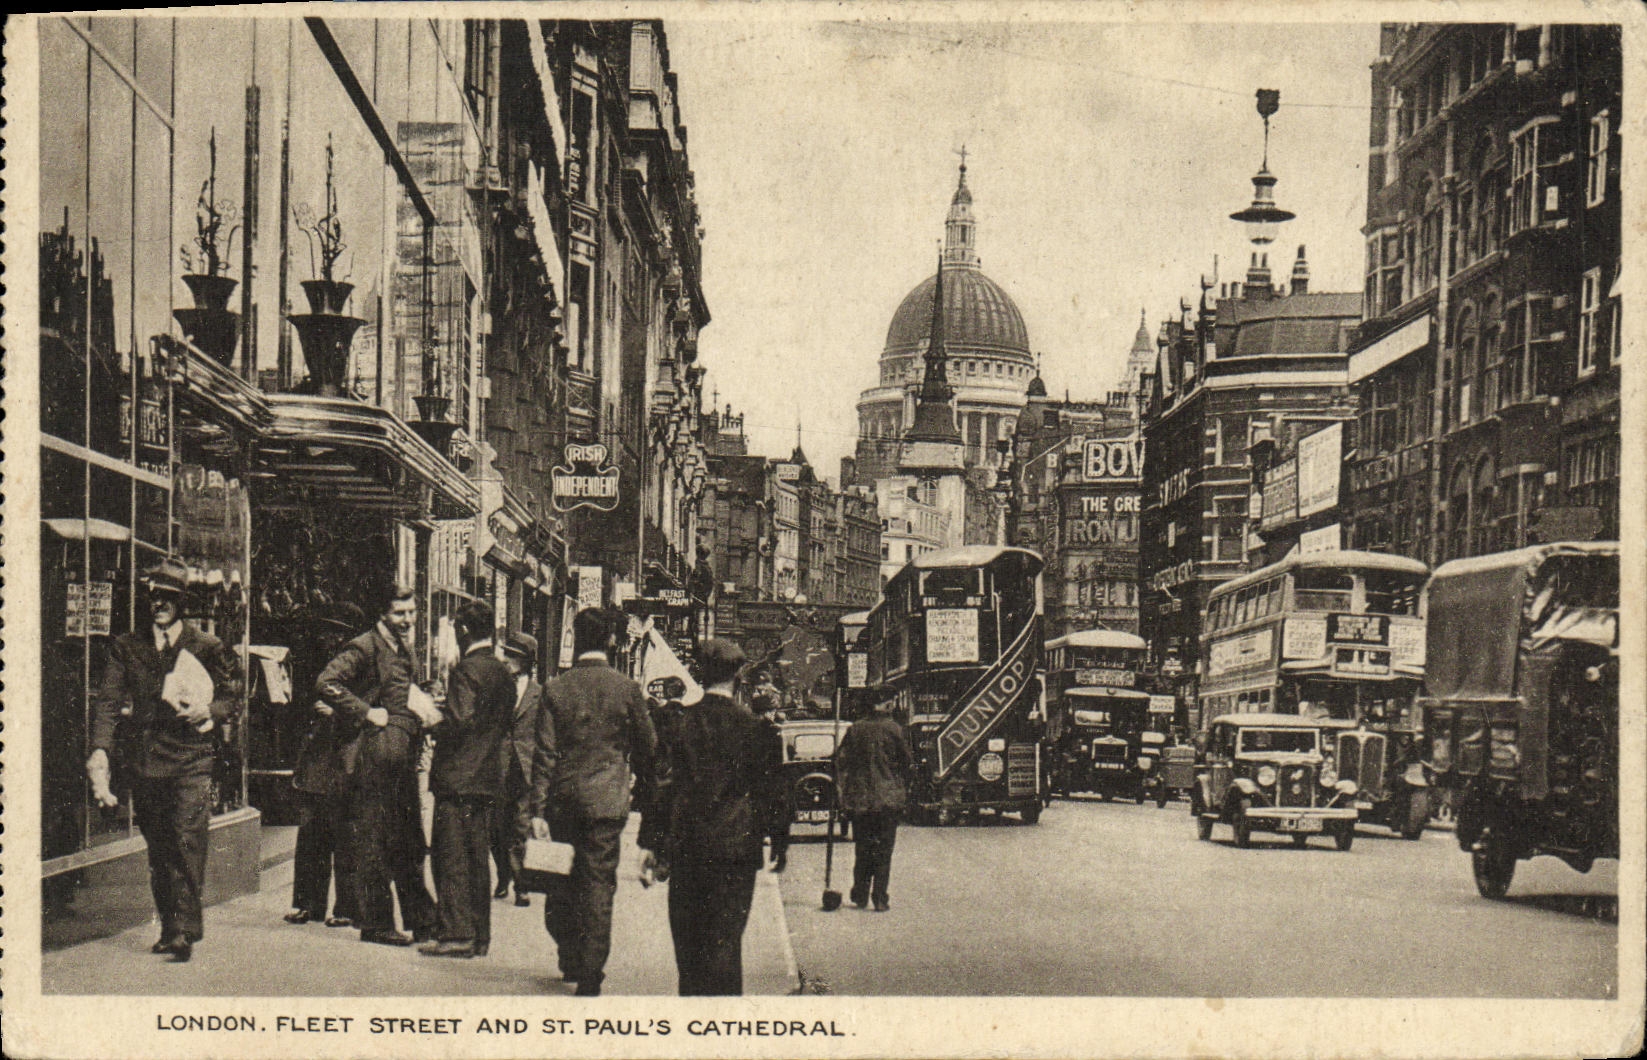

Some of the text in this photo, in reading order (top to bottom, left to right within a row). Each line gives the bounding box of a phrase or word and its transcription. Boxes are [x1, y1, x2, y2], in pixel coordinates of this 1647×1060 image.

[568, 447, 603, 461] IRISH
[555, 475, 617, 497] INDEPENDENT
[1081, 496, 1109, 512] THE
[658, 589, 686, 599] BELFAST
[946, 660, 1025, 748] DUNLOP
